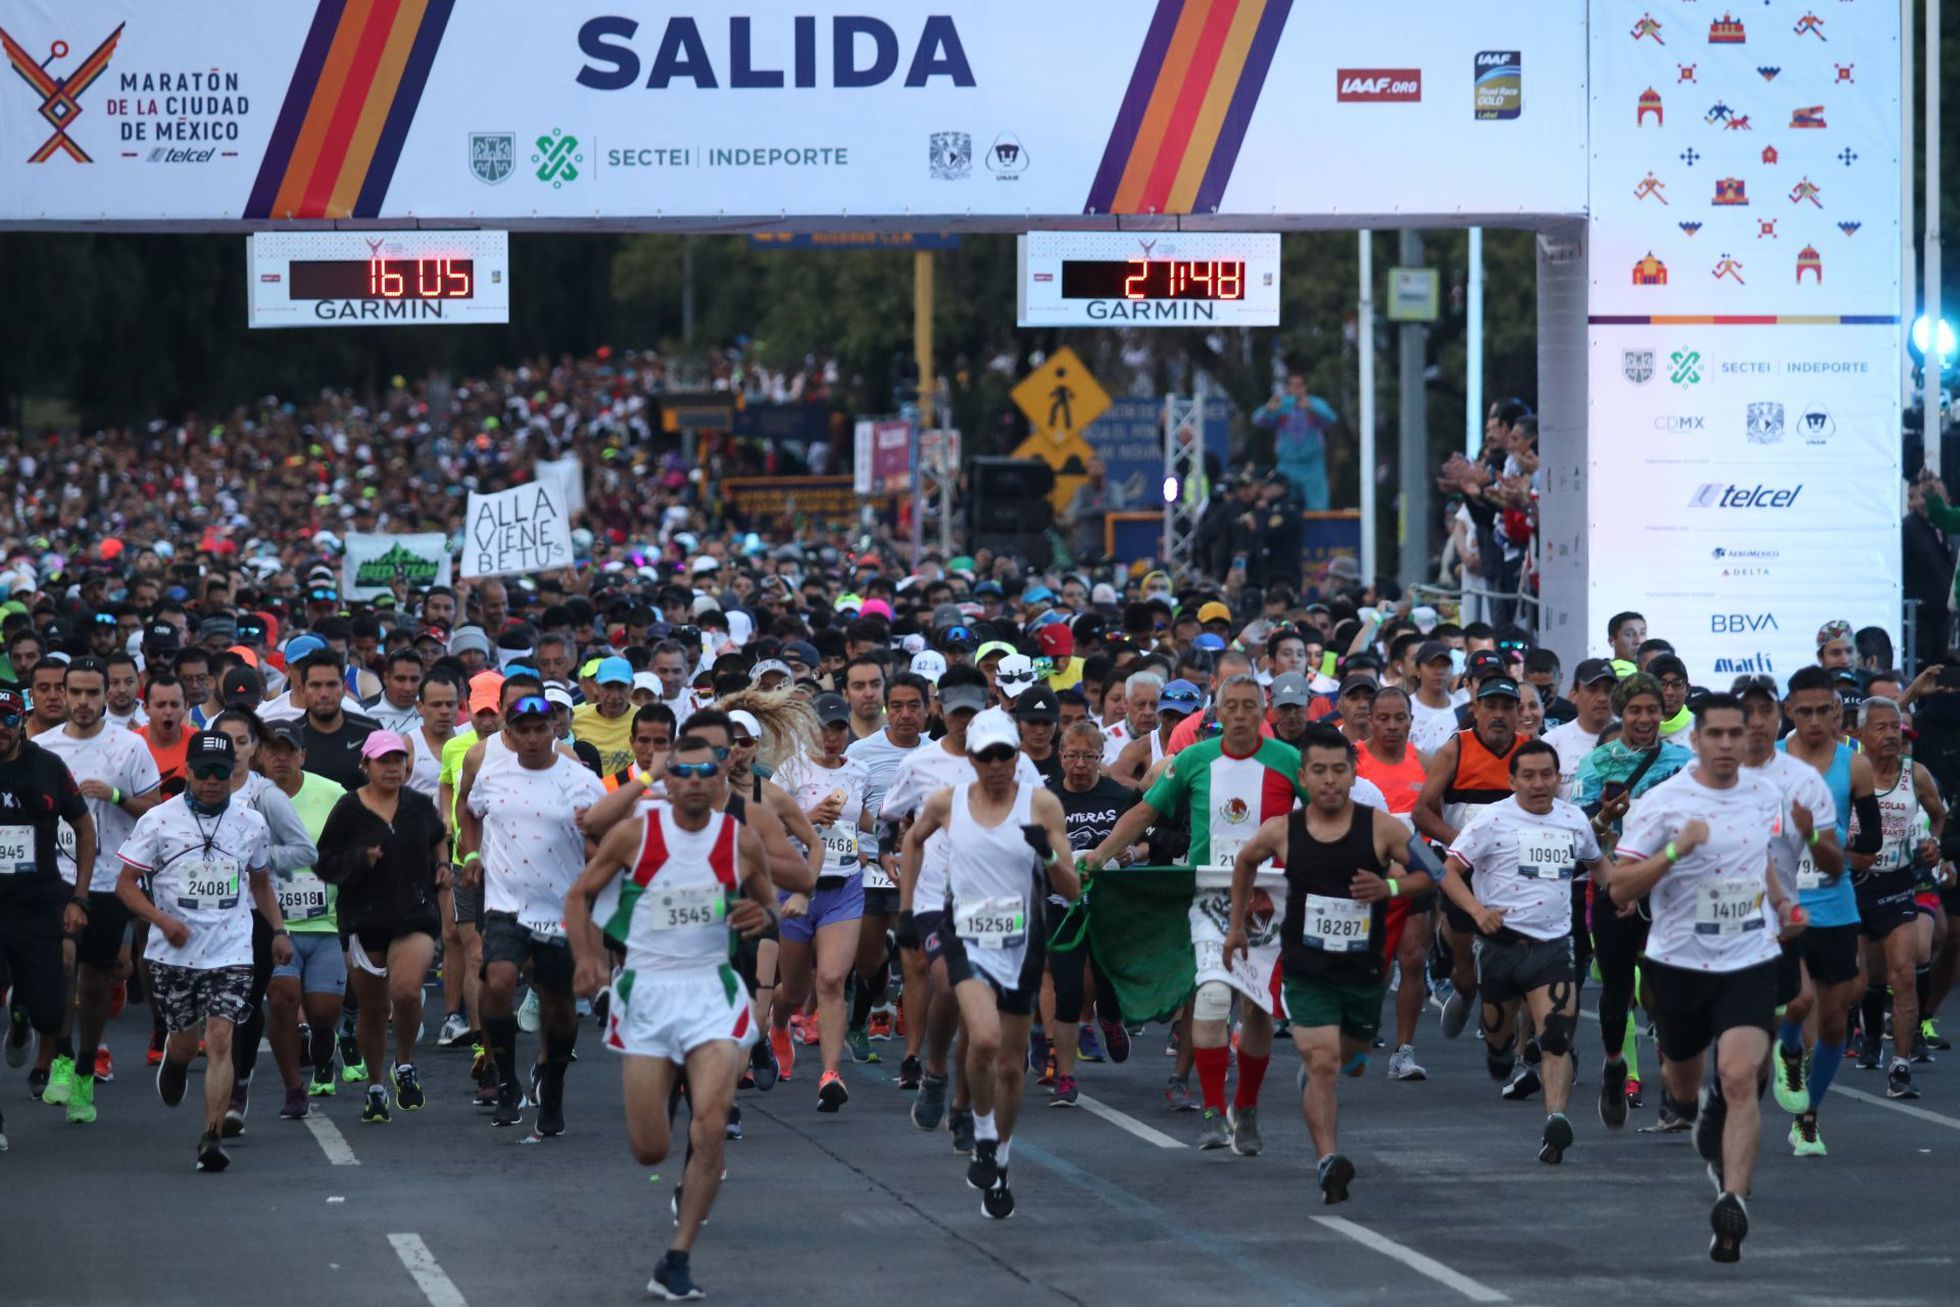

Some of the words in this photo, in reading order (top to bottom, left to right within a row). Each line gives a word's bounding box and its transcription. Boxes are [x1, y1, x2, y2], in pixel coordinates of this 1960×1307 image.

[575, 14, 978, 91] SALIDA
[1477, 53, 1511, 66] IAAF
[120, 67, 239, 92] MARATÓN
[1341, 77, 1418, 94] IAAF.ORG
[106, 98, 129, 116] DE
[136, 98, 159, 116] LA
[165, 96, 250, 116] CIUDAD
[121, 121, 147, 142] DE
[155, 116, 239, 142] MÉXICO
[164, 147, 216, 164] telcel
[607, 147, 691, 168] SECTEI
[707, 146, 850, 167] INDEPORTE
[314, 299, 443, 320] GARMIN
[1086, 299, 1215, 321] GARMIN
[1721, 361, 1771, 373] SECTEI
[1786, 361, 1869, 373] INDEPORTE
[1653, 415, 1706, 430] CDMX
[1718, 483, 1804, 508] telcel
[1733, 568, 1771, 576] DELTA
[1711, 613, 1779, 633] BBVA
[1879, 801, 1906, 811] COLAS
[1065, 809, 1117, 824] NTERAS
[1220, 854, 1235, 867] 21
[1529, 847, 1569, 864] 10902
[188, 880, 230, 896] 24081
[668, 907, 711, 926] 3545
[967, 916, 1014, 933] 15258
[1315, 917, 1361, 937] 18287
